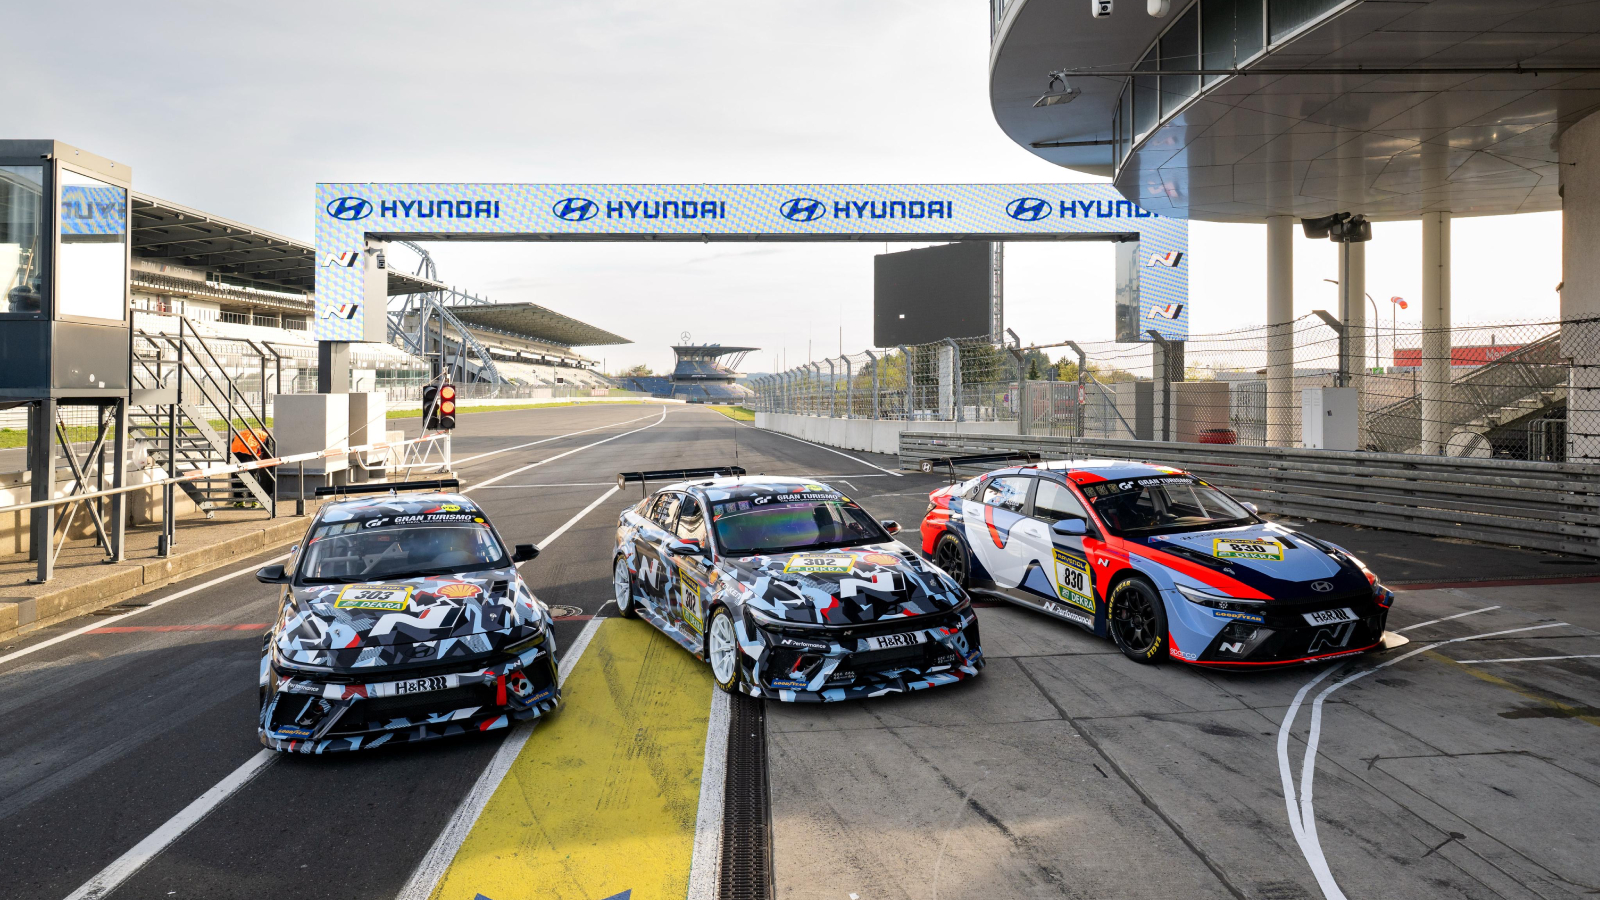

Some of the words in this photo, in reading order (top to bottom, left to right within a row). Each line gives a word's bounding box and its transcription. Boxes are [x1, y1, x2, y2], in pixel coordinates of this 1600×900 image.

[380, 200, 500, 219] HYUNDAI
[606, 200, 726, 219] HYUNDAI
[833, 200, 952, 219] HYUNDAI
[776, 493, 801, 501] GRAN
[394, 514, 425, 523] GRAN
[1229, 543, 1267, 553] 830
[803, 558, 837, 566] 302
[1057, 553, 1084, 569] RAVENOL
[1234, 552, 1277, 560] DEKRA
[1064, 567, 1084, 592] 830
[354, 590, 395, 600] 303
[685, 588, 697, 614] 302
[1071, 591, 1095, 610] DEKRA
[359, 601, 401, 609] DEKRA
[1057, 605, 1092, 625] Performance
[1215, 611, 1262, 622] GOODYEAR
[1311, 611, 1337, 623] H&R
[792, 640, 827, 649] Performance
[877, 634, 904, 648] H&R
[1146, 635, 1162, 659] EAGLE
[1169, 648, 1197, 660] sparco
[287, 682, 320, 692] Performance
[395, 679, 428, 695] H&R
[276, 728, 311, 736] GOODYEAR
